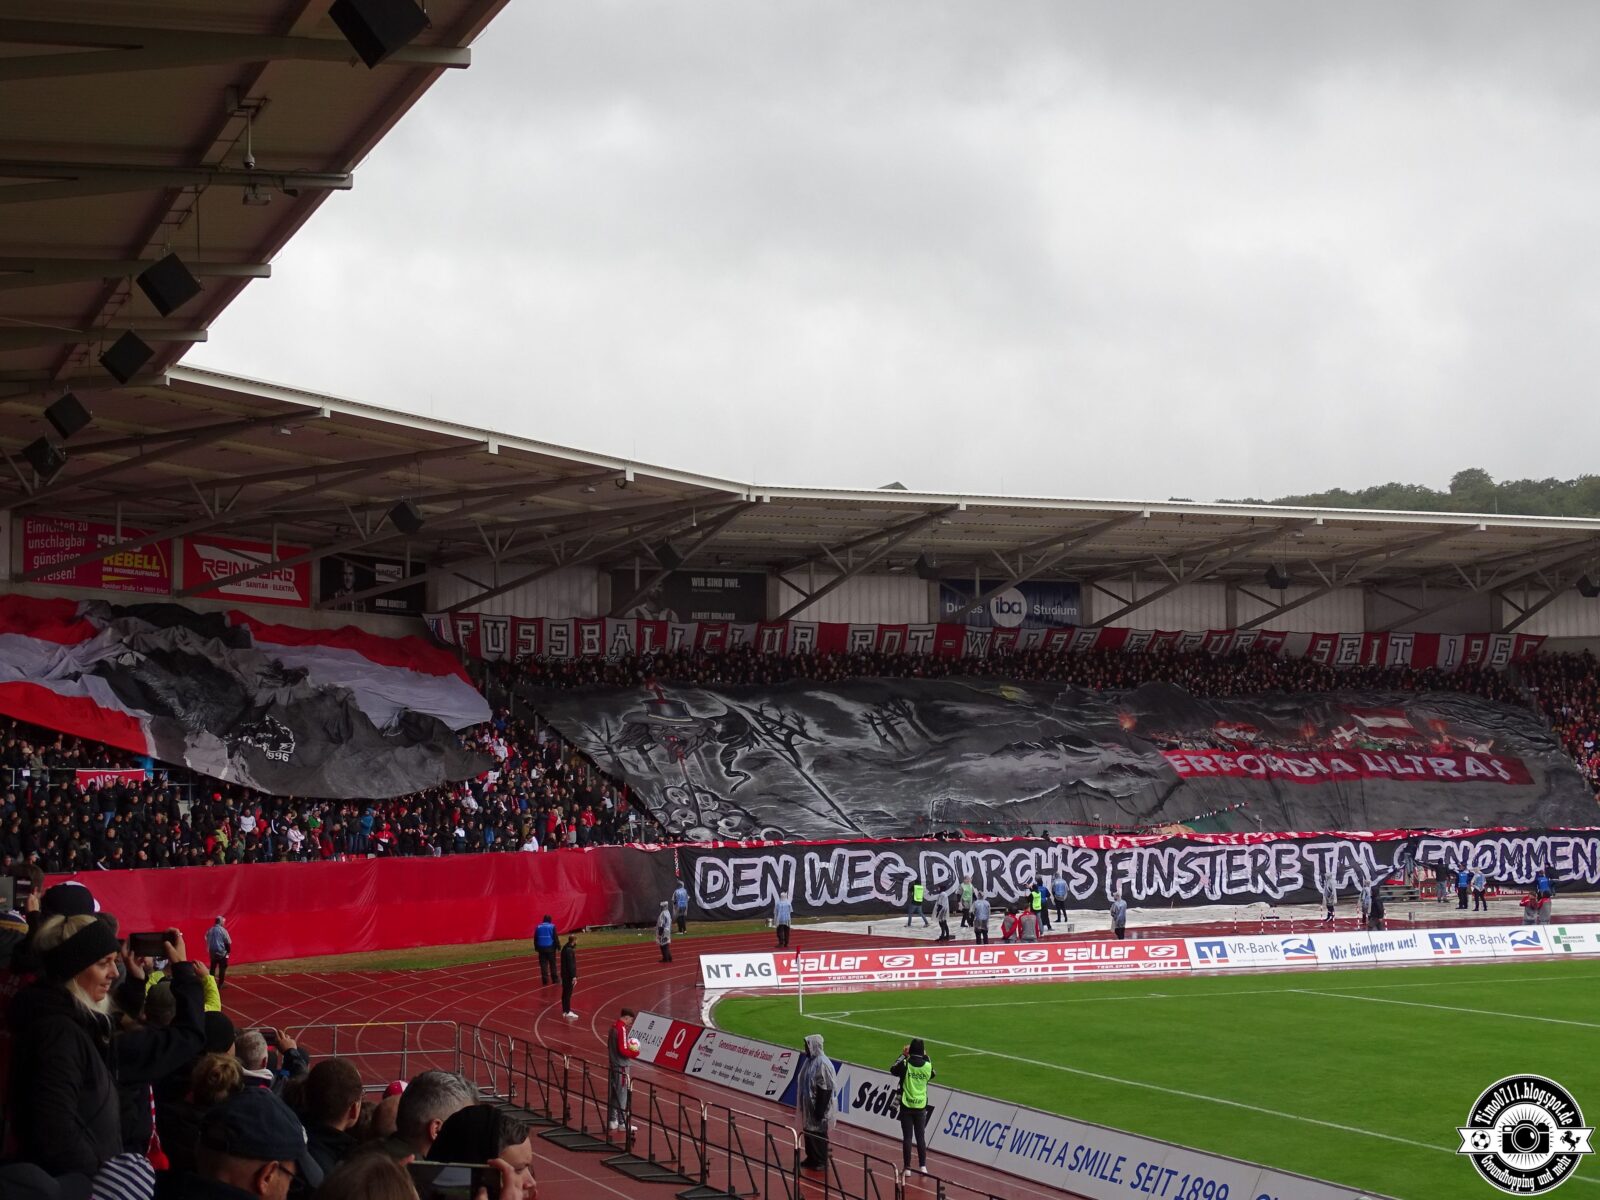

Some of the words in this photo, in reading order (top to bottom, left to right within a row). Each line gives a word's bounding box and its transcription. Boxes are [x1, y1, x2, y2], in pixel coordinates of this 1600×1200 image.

[28, 533, 86, 550] unschlagbar
[103, 553, 160, 569] REBELL
[691, 577, 705, 587] WIR
[995, 597, 1022, 615] iba
[1033, 604, 1078, 616] Studium
[1312, 637, 1412, 666] SEIT
[1166, 754, 1357, 778] ERFORDIA
[1359, 752, 1512, 781] ULTRAS
[695, 854, 796, 911] DEN
[804, 848, 918, 907] WEG
[1106, 843, 1303, 903] FINSTERE
[1394, 837, 1600, 884] ENOMMEN
[1228, 941, 1280, 955] VR-Bank
[1328, 945, 1348, 960] Wir
[1350, 942, 1394, 957] kümmern
[1397, 934, 1418, 952] uns!
[1460, 933, 1508, 946] VR-Bank
[943, 1111, 1011, 1150] SERVICE
[1009, 1128, 1057, 1163] WITH
[1052, 1142, 1069, 1168] A
[1068, 1145, 1127, 1185] SMILE.
[1130, 1162, 1178, 1197] SEIT
[1174, 1174, 1230, 1200] 1899
